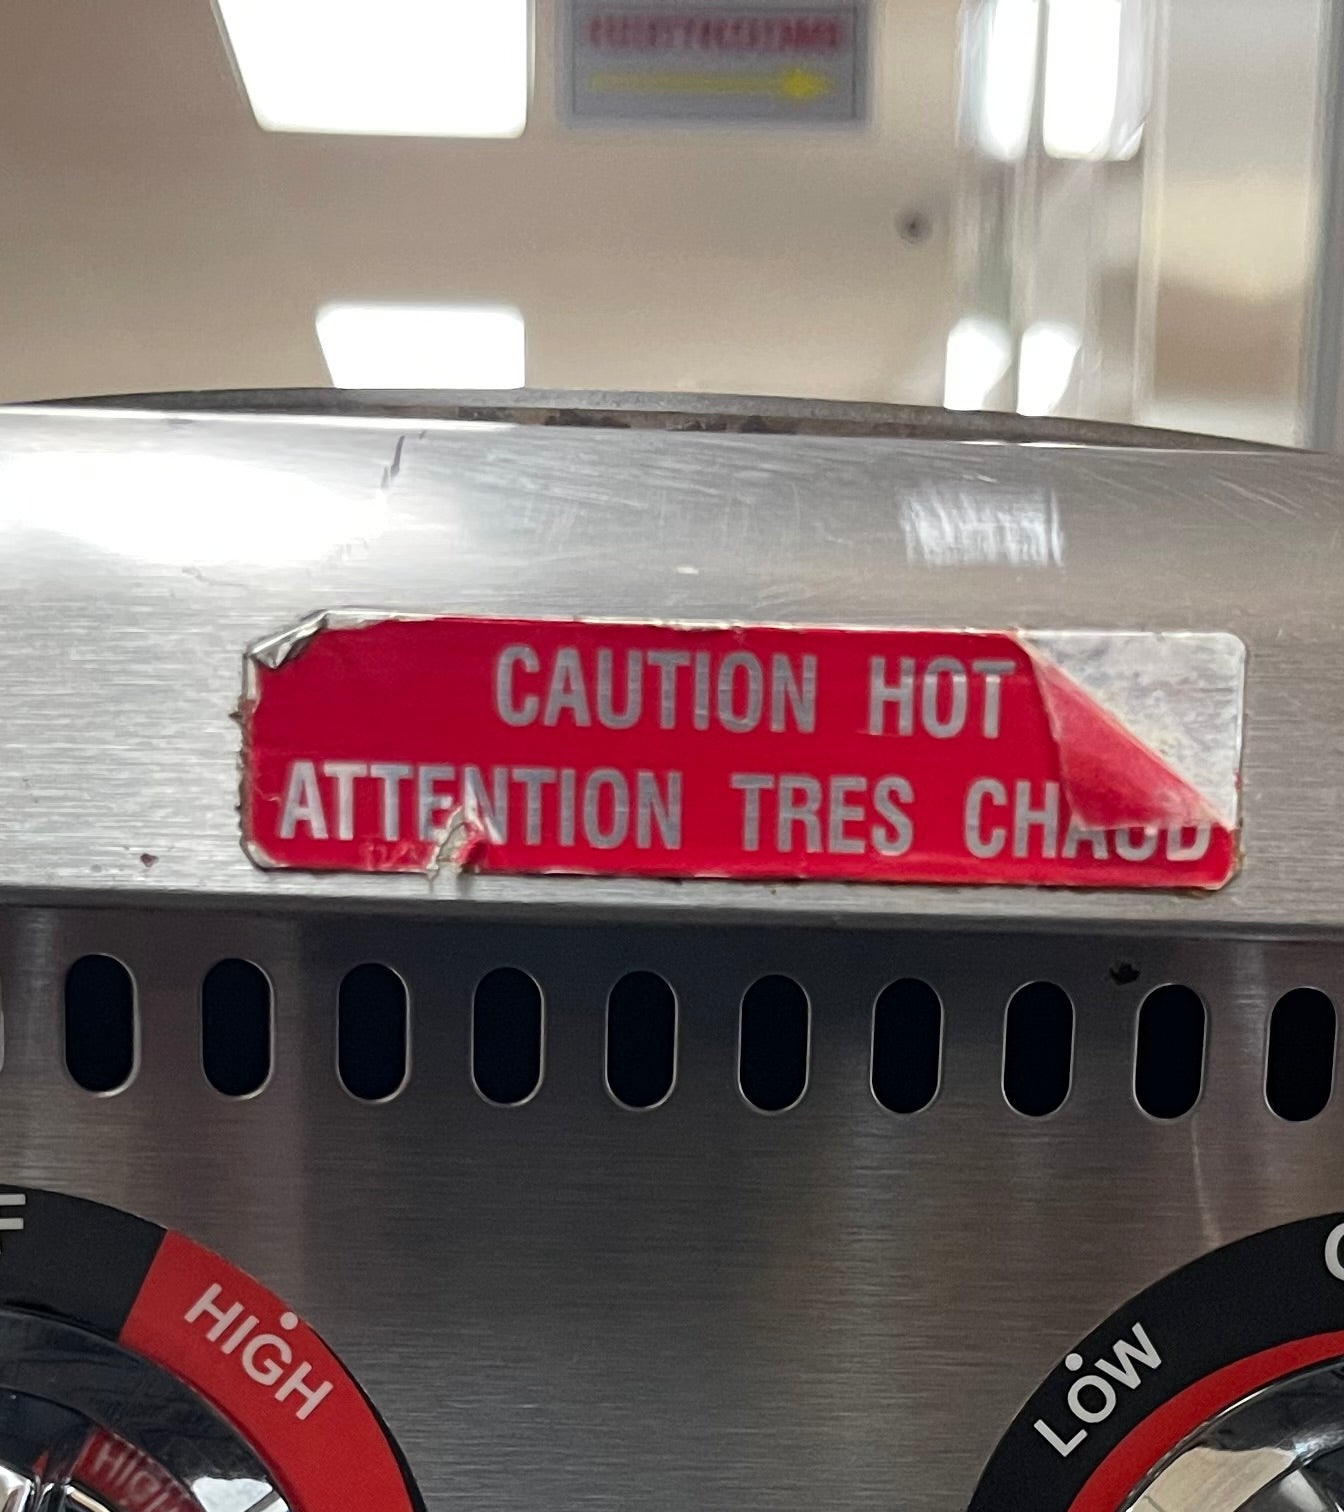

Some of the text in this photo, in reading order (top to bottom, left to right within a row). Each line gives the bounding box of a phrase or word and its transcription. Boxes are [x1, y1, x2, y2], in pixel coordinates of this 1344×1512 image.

[495, 645, 1016, 739] CAUTION HOT
[278, 762, 682, 850] ATTENTION
[730, 775, 915, 858] TRES
[184, 1283, 334, 1422] HIGH
[1034, 1323, 1163, 1459] LOW
